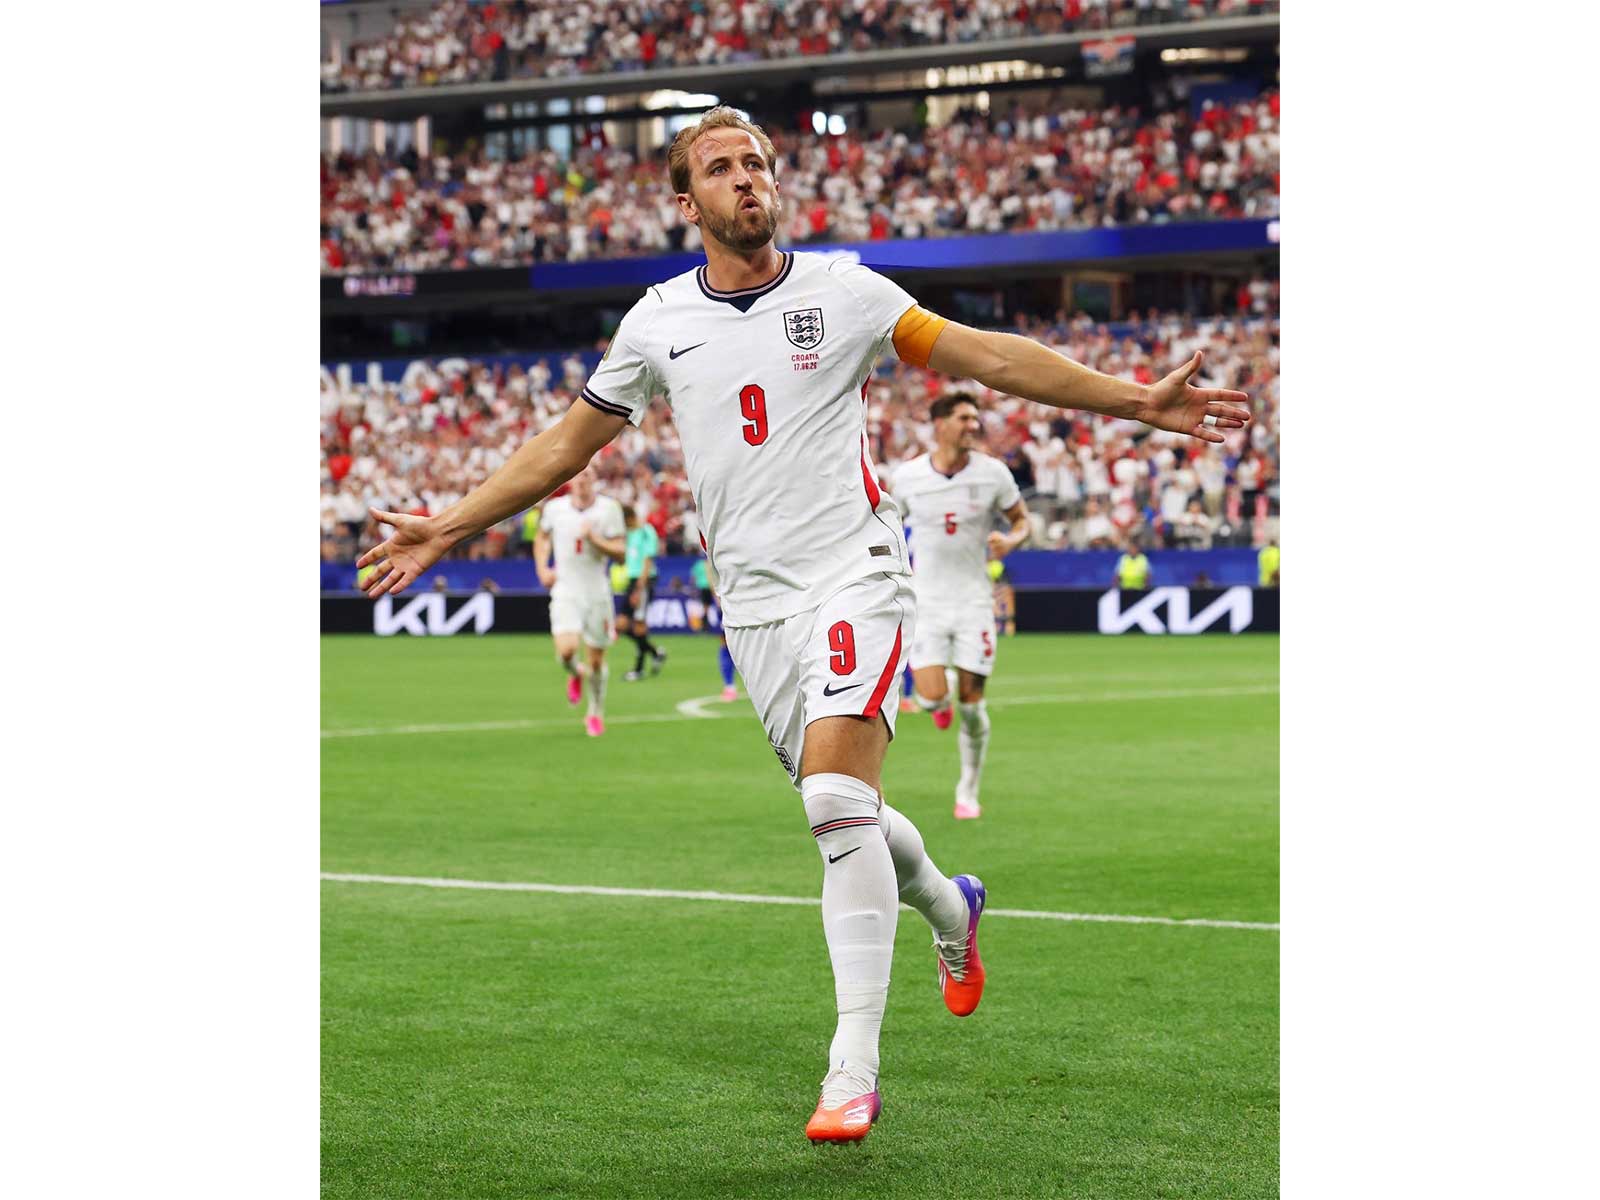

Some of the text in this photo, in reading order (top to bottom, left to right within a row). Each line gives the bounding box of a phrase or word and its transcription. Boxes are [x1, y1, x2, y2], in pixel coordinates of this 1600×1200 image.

[791, 353, 820, 362] CROATIA
[739, 383, 769, 447] 9
[944, 512, 957, 536] 5
[373, 591, 495, 636] KIA
[1097, 585, 1254, 634] KIA
[828, 619, 857, 677] 9
